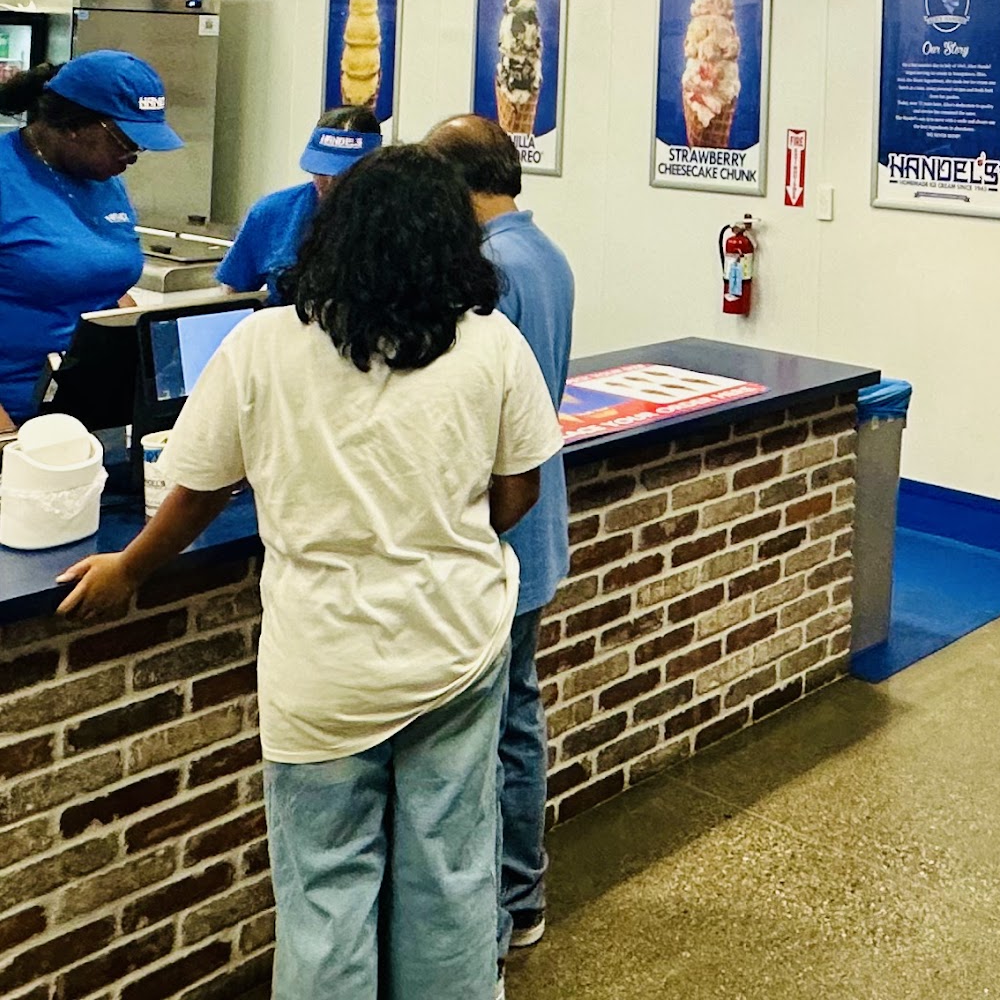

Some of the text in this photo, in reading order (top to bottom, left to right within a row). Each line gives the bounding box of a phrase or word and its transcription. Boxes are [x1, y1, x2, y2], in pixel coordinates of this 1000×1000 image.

[922, 40, 969, 58] Our Story
[669, 148, 746, 166] STRAWBERRY
[658, 163, 756, 182] CHEESECAKE CHUNK
[889, 154, 999, 185] HANDEL'S
[600, 412, 659, 427] YOUR
